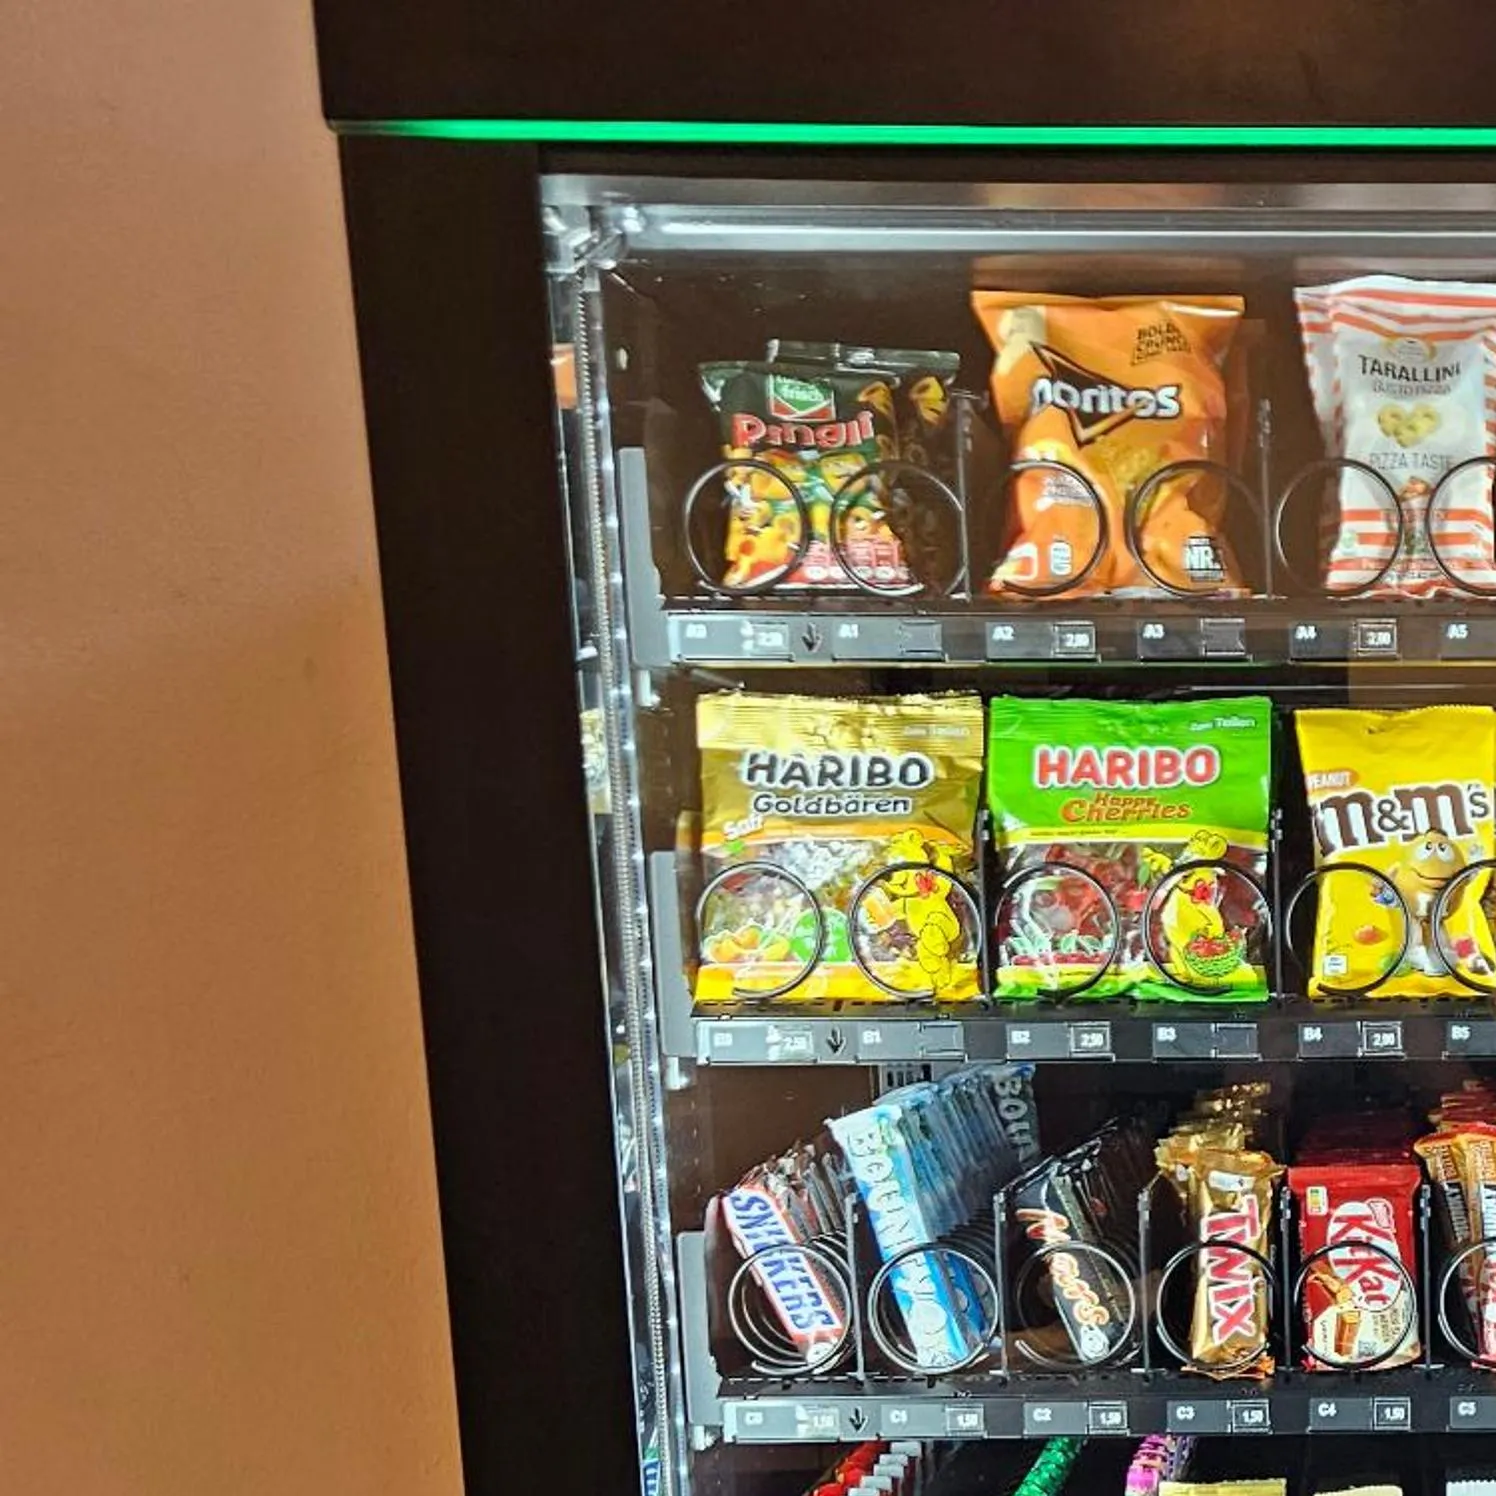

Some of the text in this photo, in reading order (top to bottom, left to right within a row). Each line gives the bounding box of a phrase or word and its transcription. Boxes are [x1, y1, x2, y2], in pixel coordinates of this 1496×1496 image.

[1359, 355, 1462, 383] TARALLINI
[743, 751, 933, 788] HARIBO
[1035, 746, 1220, 787] HARIBO
[752, 793, 911, 818] Goldbären
[1060, 799, 1193, 824] Cherries
[1205, 1195, 1260, 1342] TWIX
